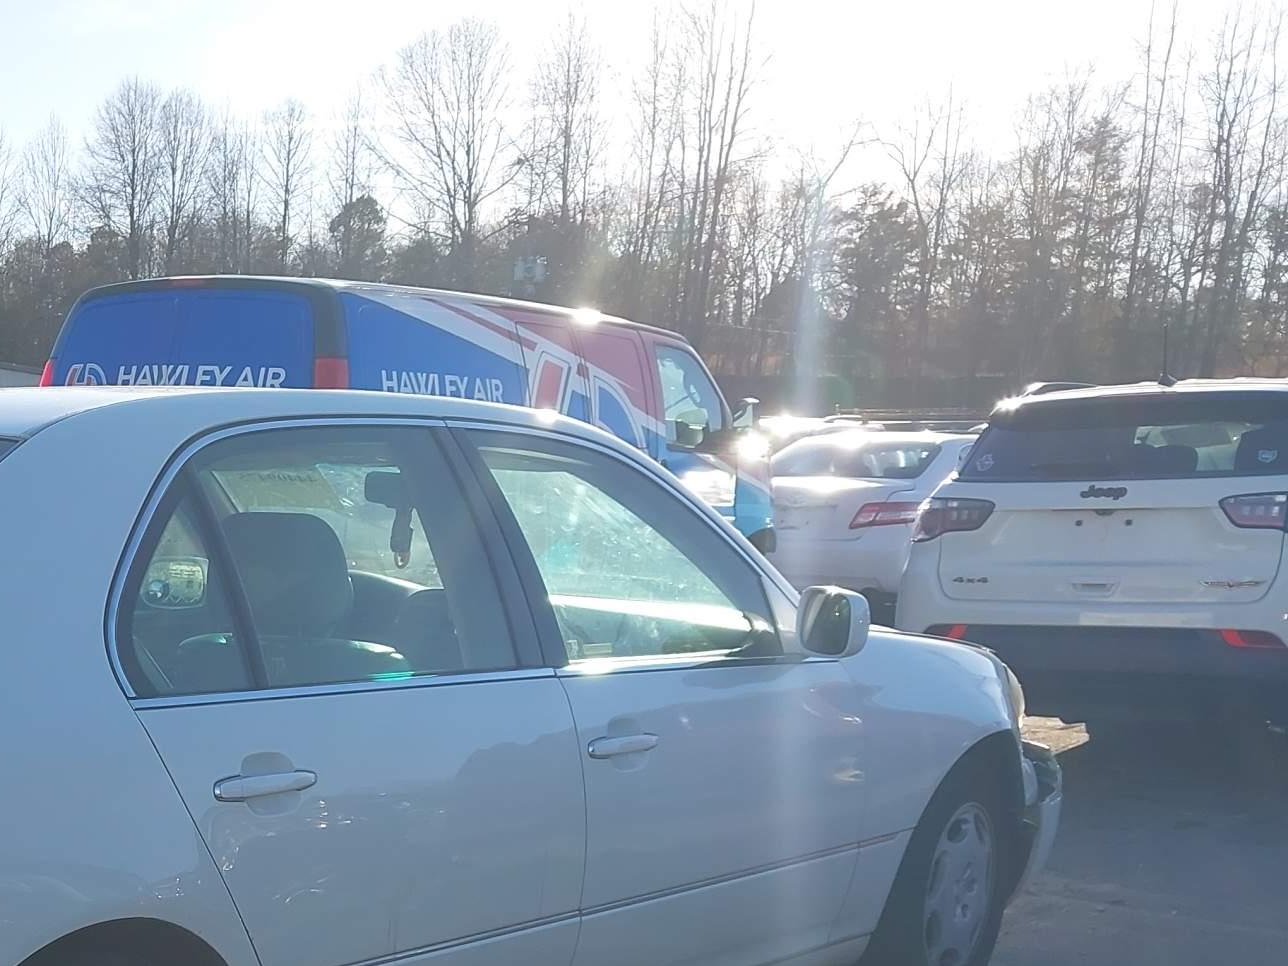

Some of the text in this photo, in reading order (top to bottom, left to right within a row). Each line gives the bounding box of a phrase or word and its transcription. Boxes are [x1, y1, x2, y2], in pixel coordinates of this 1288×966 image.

[117, 364, 287, 389] HAWLEY AIR
[381, 369, 505, 403] HAWLEY AIR
[1079, 484, 1128, 501] Jeep
